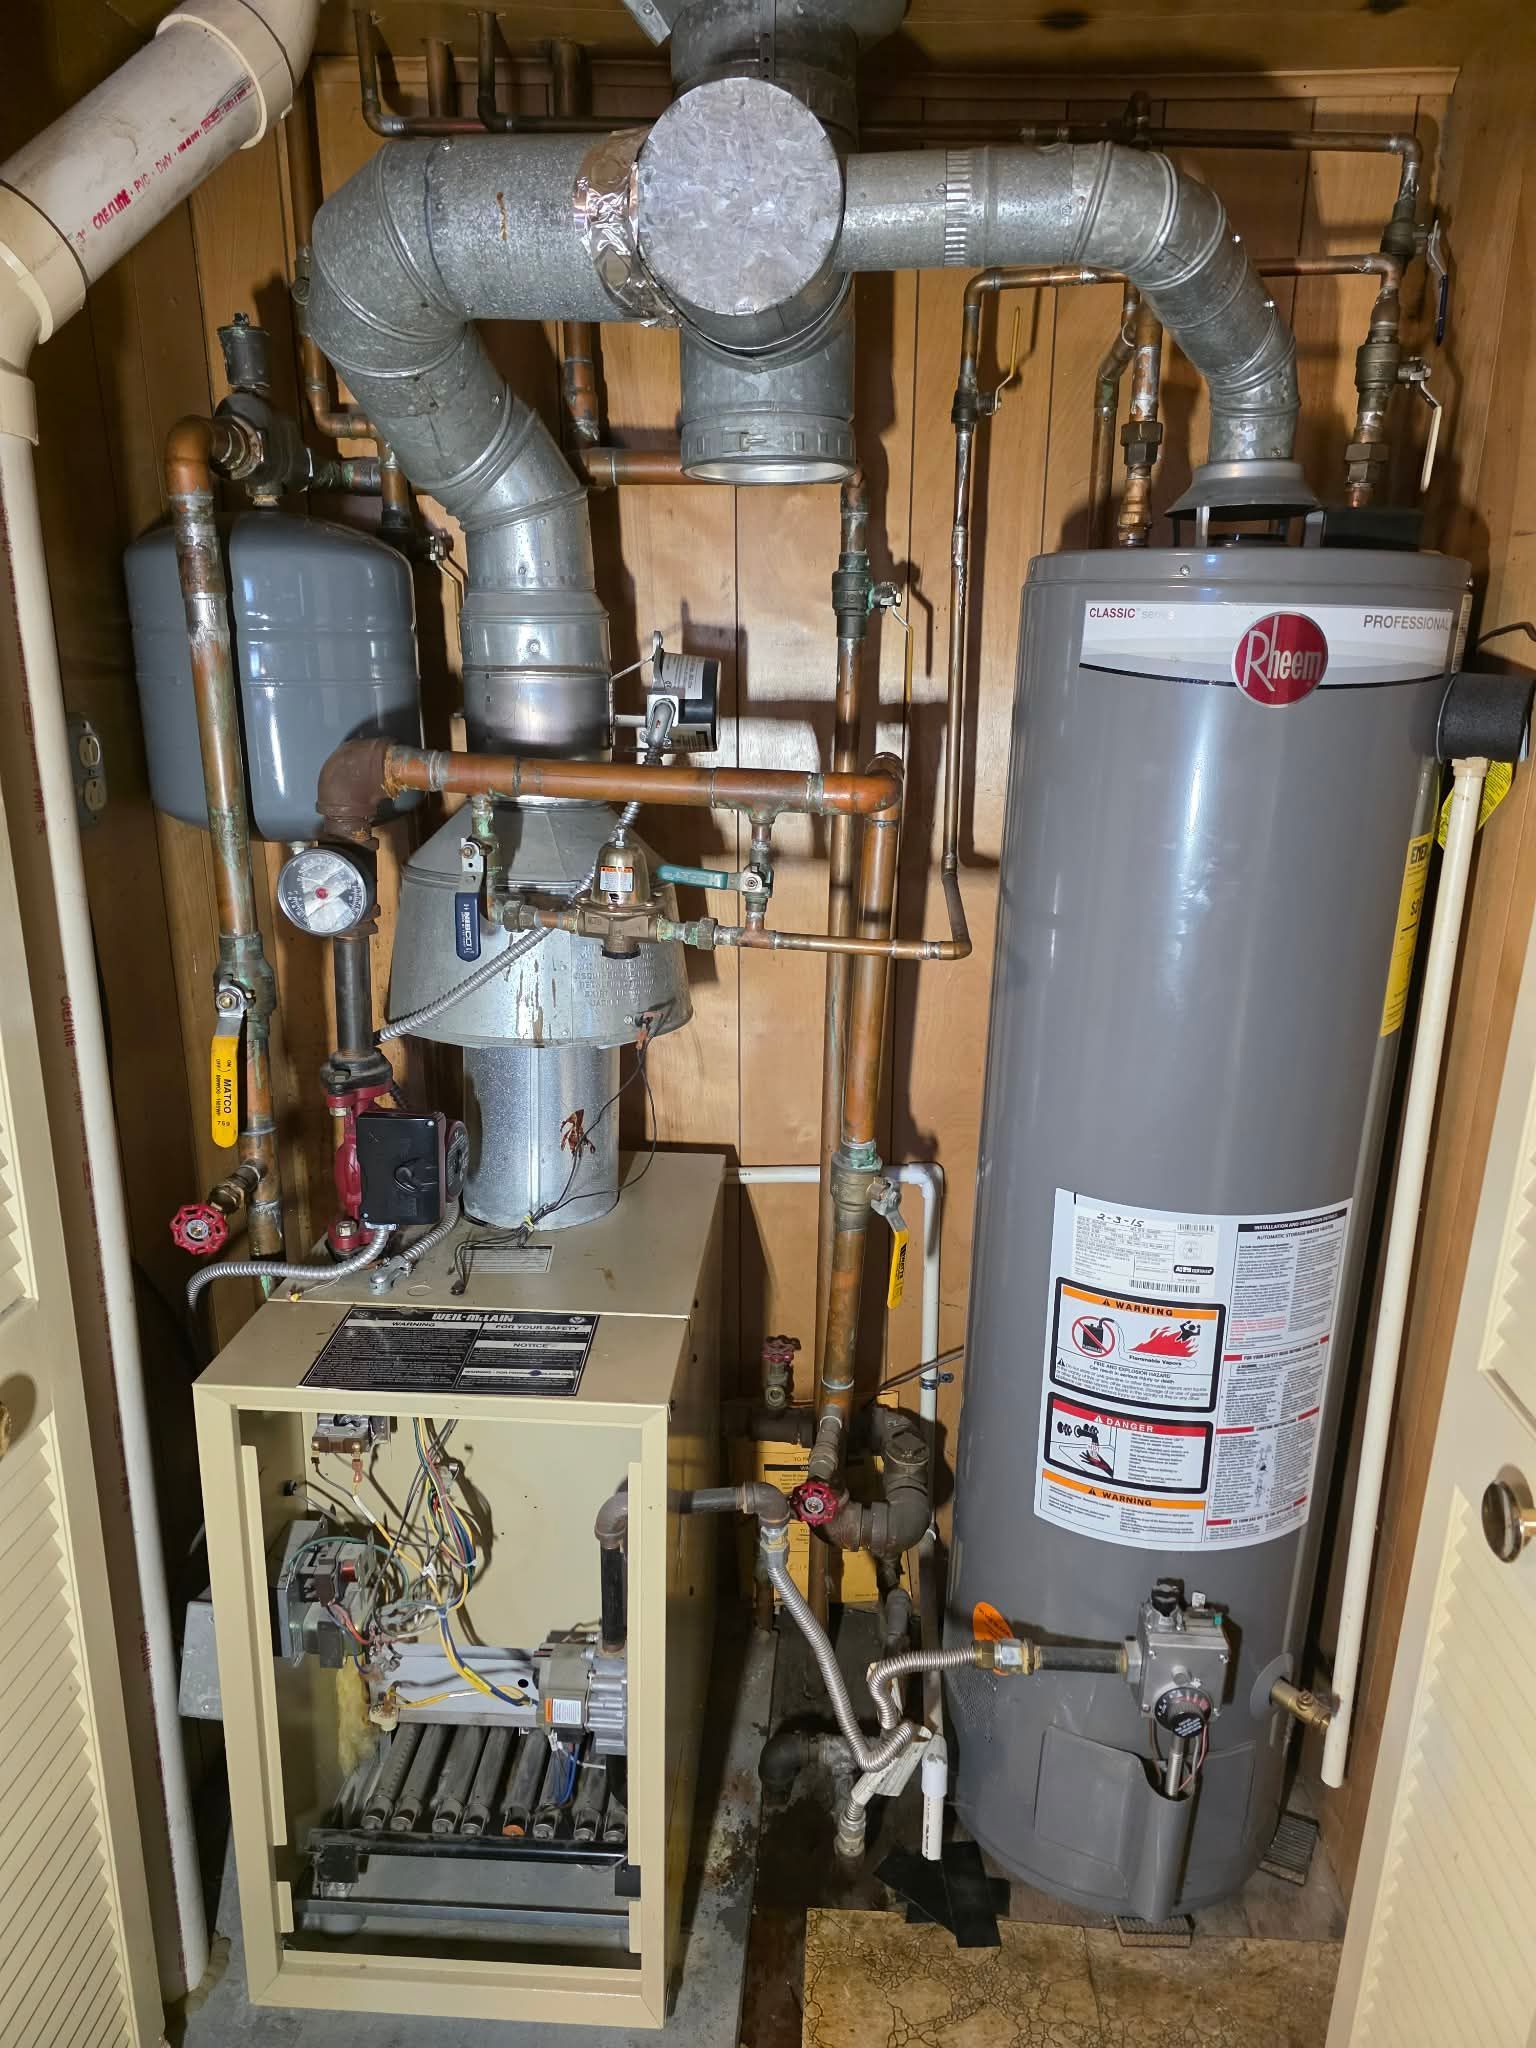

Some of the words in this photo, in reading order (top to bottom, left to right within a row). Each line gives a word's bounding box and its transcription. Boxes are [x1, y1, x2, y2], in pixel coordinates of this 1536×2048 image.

[133, 173, 151, 193] PVC
[155, 153, 173, 174] DWV
[1089, 607, 1136, 619] CLASSIC
[1363, 614, 1449, 632] PROFESSIONAL
[1243, 615, 1323, 692] Rheem
[464, 911, 472, 947] NIBCO
[223, 1078, 232, 1114] MATCO
[1096, 1213, 1145, 1228] 2-3-15
[1115, 1301, 1173, 1317] WARNING
[1106, 1417, 1154, 1433] DANGER
[1102, 1491, 1152, 1507] WARNING
